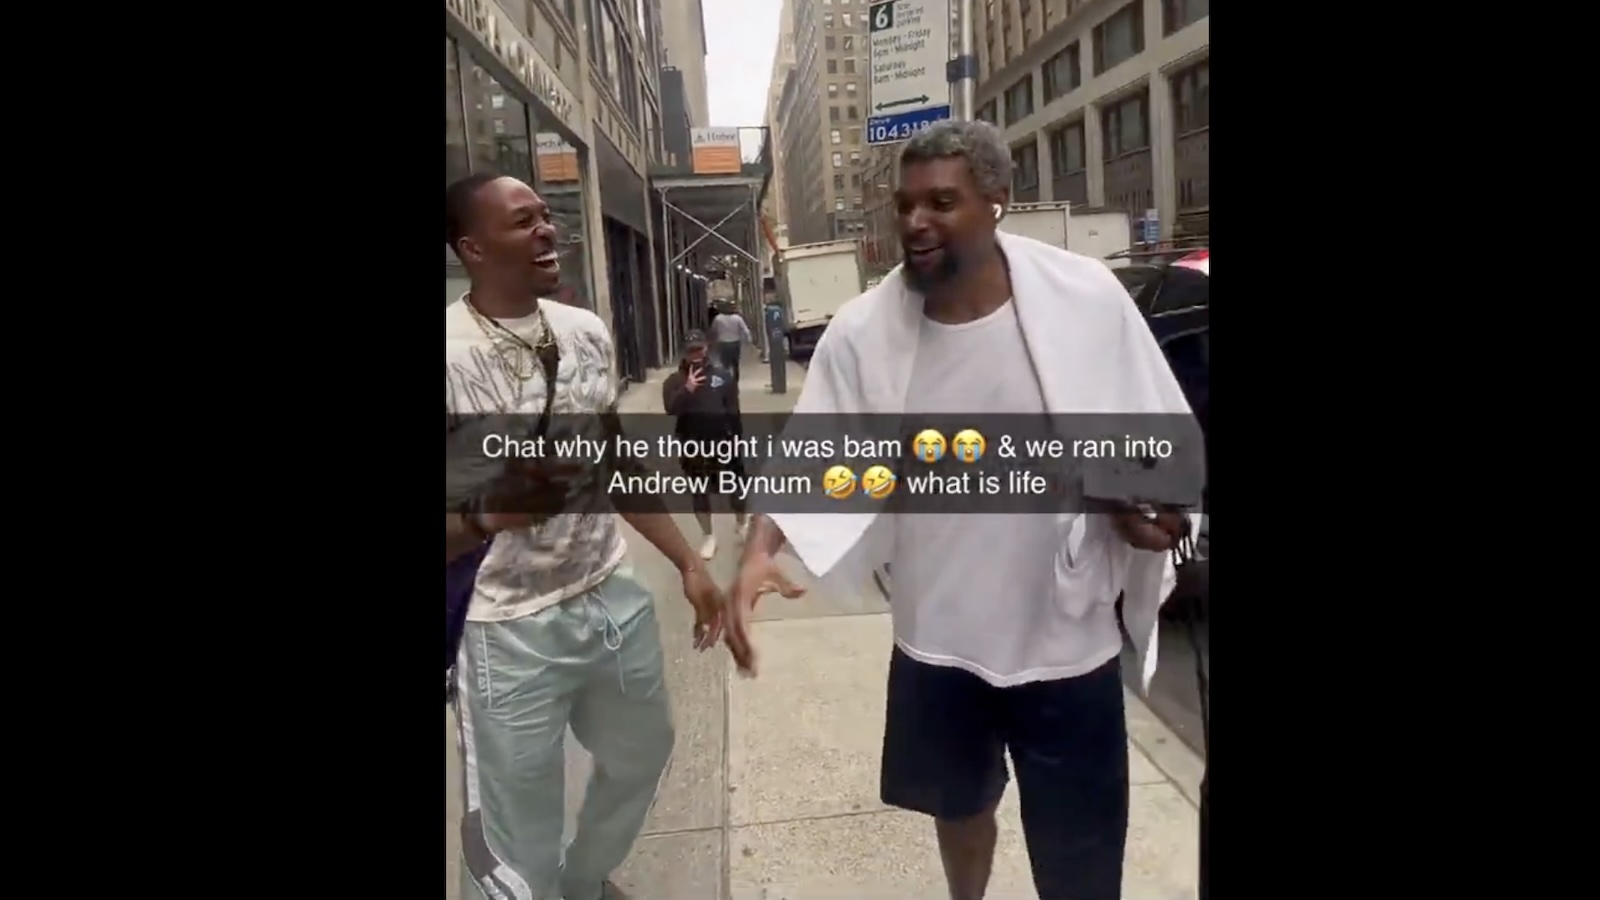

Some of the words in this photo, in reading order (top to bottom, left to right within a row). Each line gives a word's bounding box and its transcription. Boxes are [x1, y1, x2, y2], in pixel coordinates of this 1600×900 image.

[875, 4, 889, 29] 6
[907, 28, 931, 39] Friday
[895, 39, 925, 54] Midnight
[873, 62, 906, 74] Saturday
[895, 67, 926, 81] Midnight
